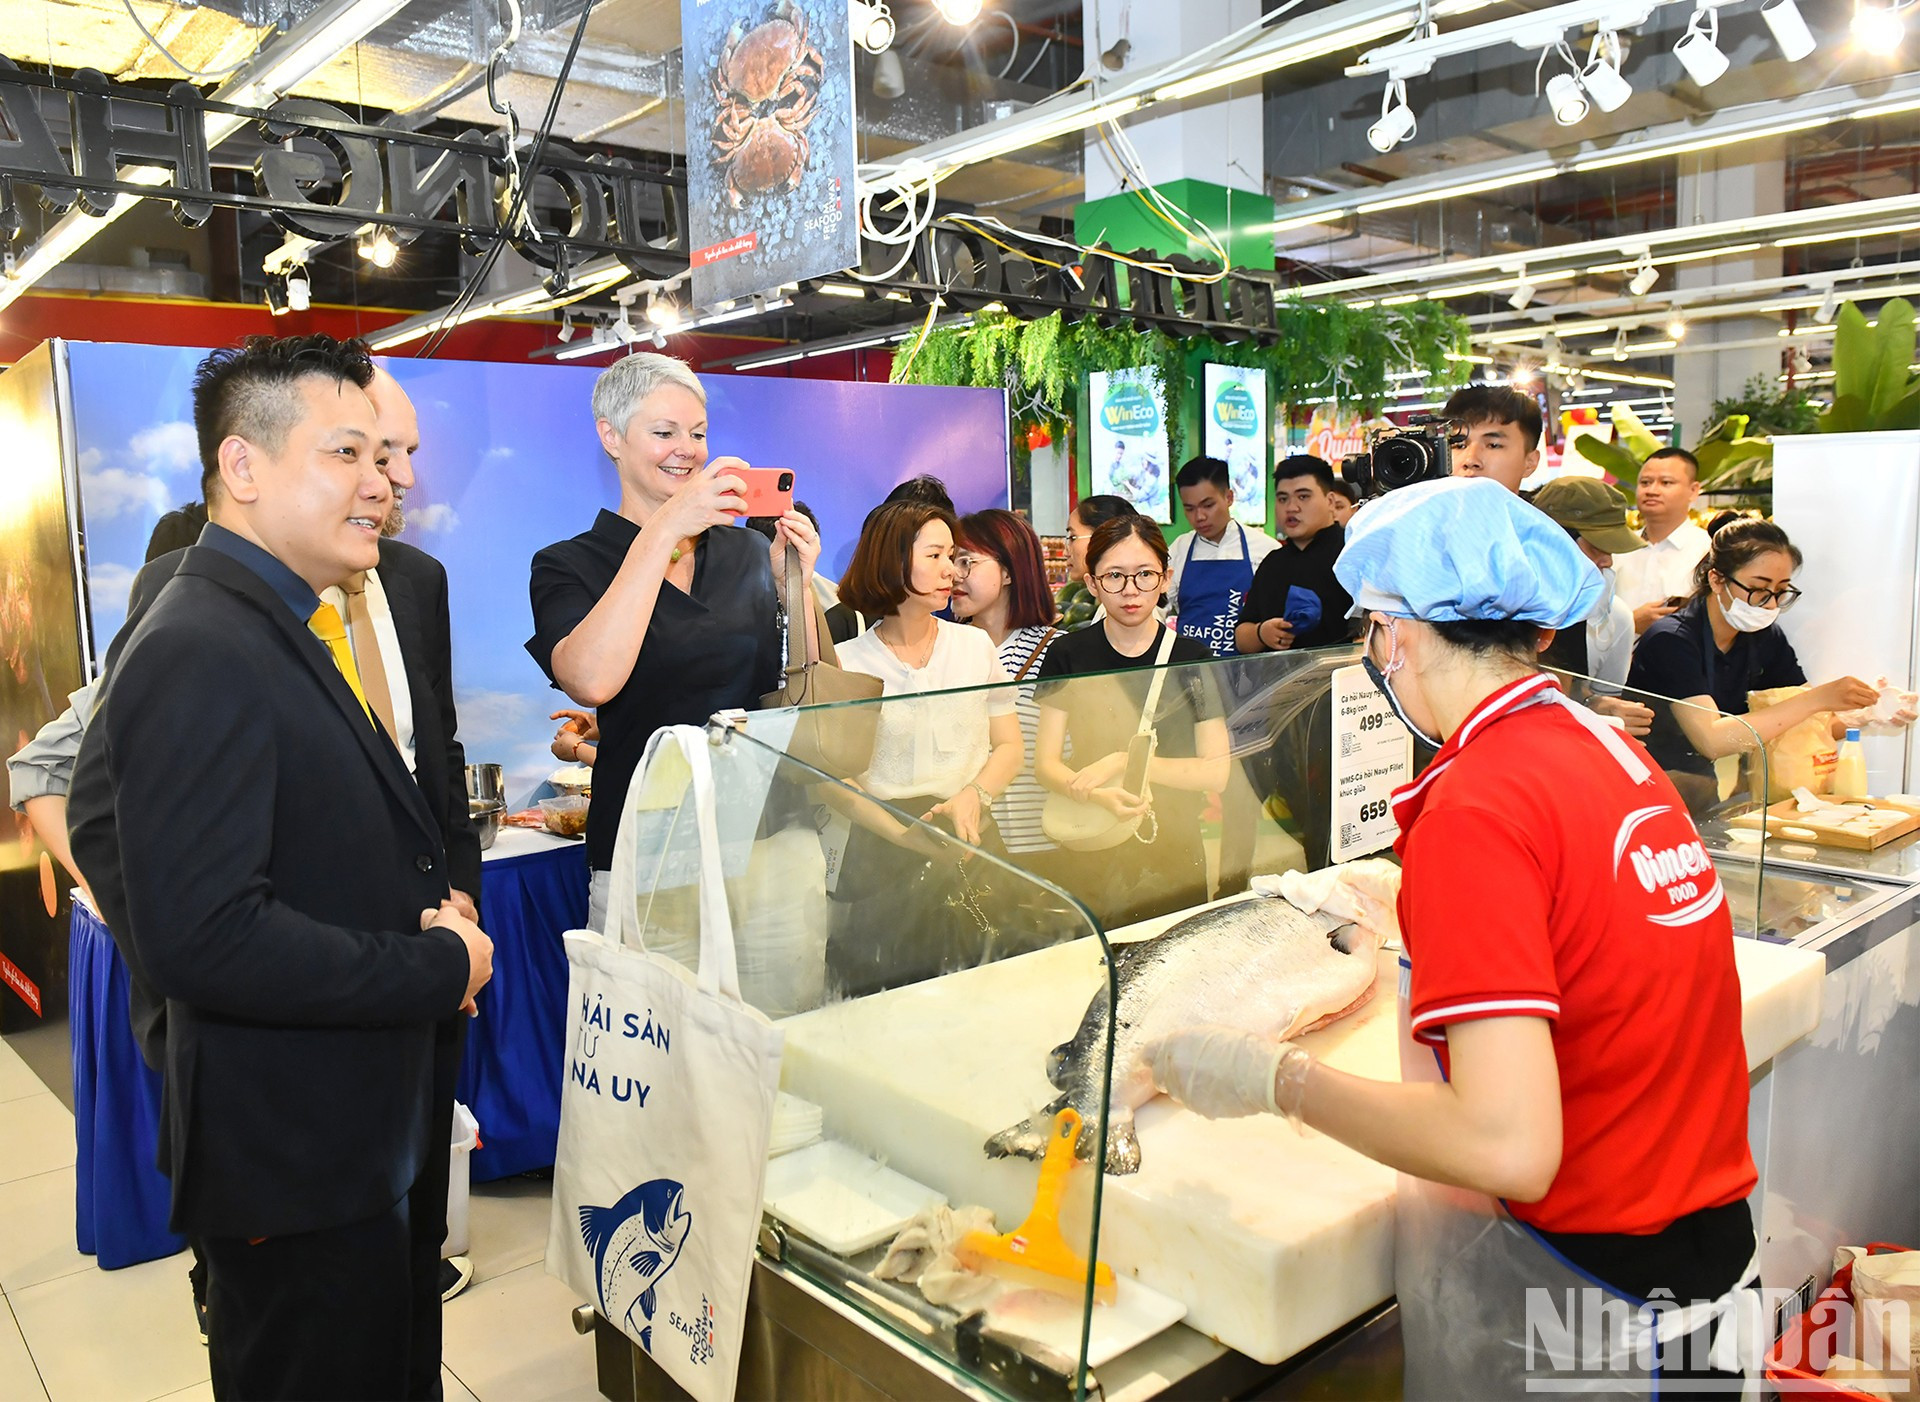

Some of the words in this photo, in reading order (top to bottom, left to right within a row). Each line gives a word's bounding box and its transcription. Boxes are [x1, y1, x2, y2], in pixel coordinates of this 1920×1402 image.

[804, 210, 843, 231] SEAFOOD
[1104, 404, 1155, 425] WinEco
[1183, 624, 1236, 641] SEAFOO
[1360, 713, 1383, 731] 499
[1389, 763, 1404, 772] Fillet
[1360, 799, 1388, 823] 659
[1667, 881, 1699, 905] FOOD
[582, 992, 611, 1033] HẢI
[622, 1008, 670, 1055] SẢN
[571, 1057, 601, 1096] NA
[612, 1075, 651, 1109] UY
